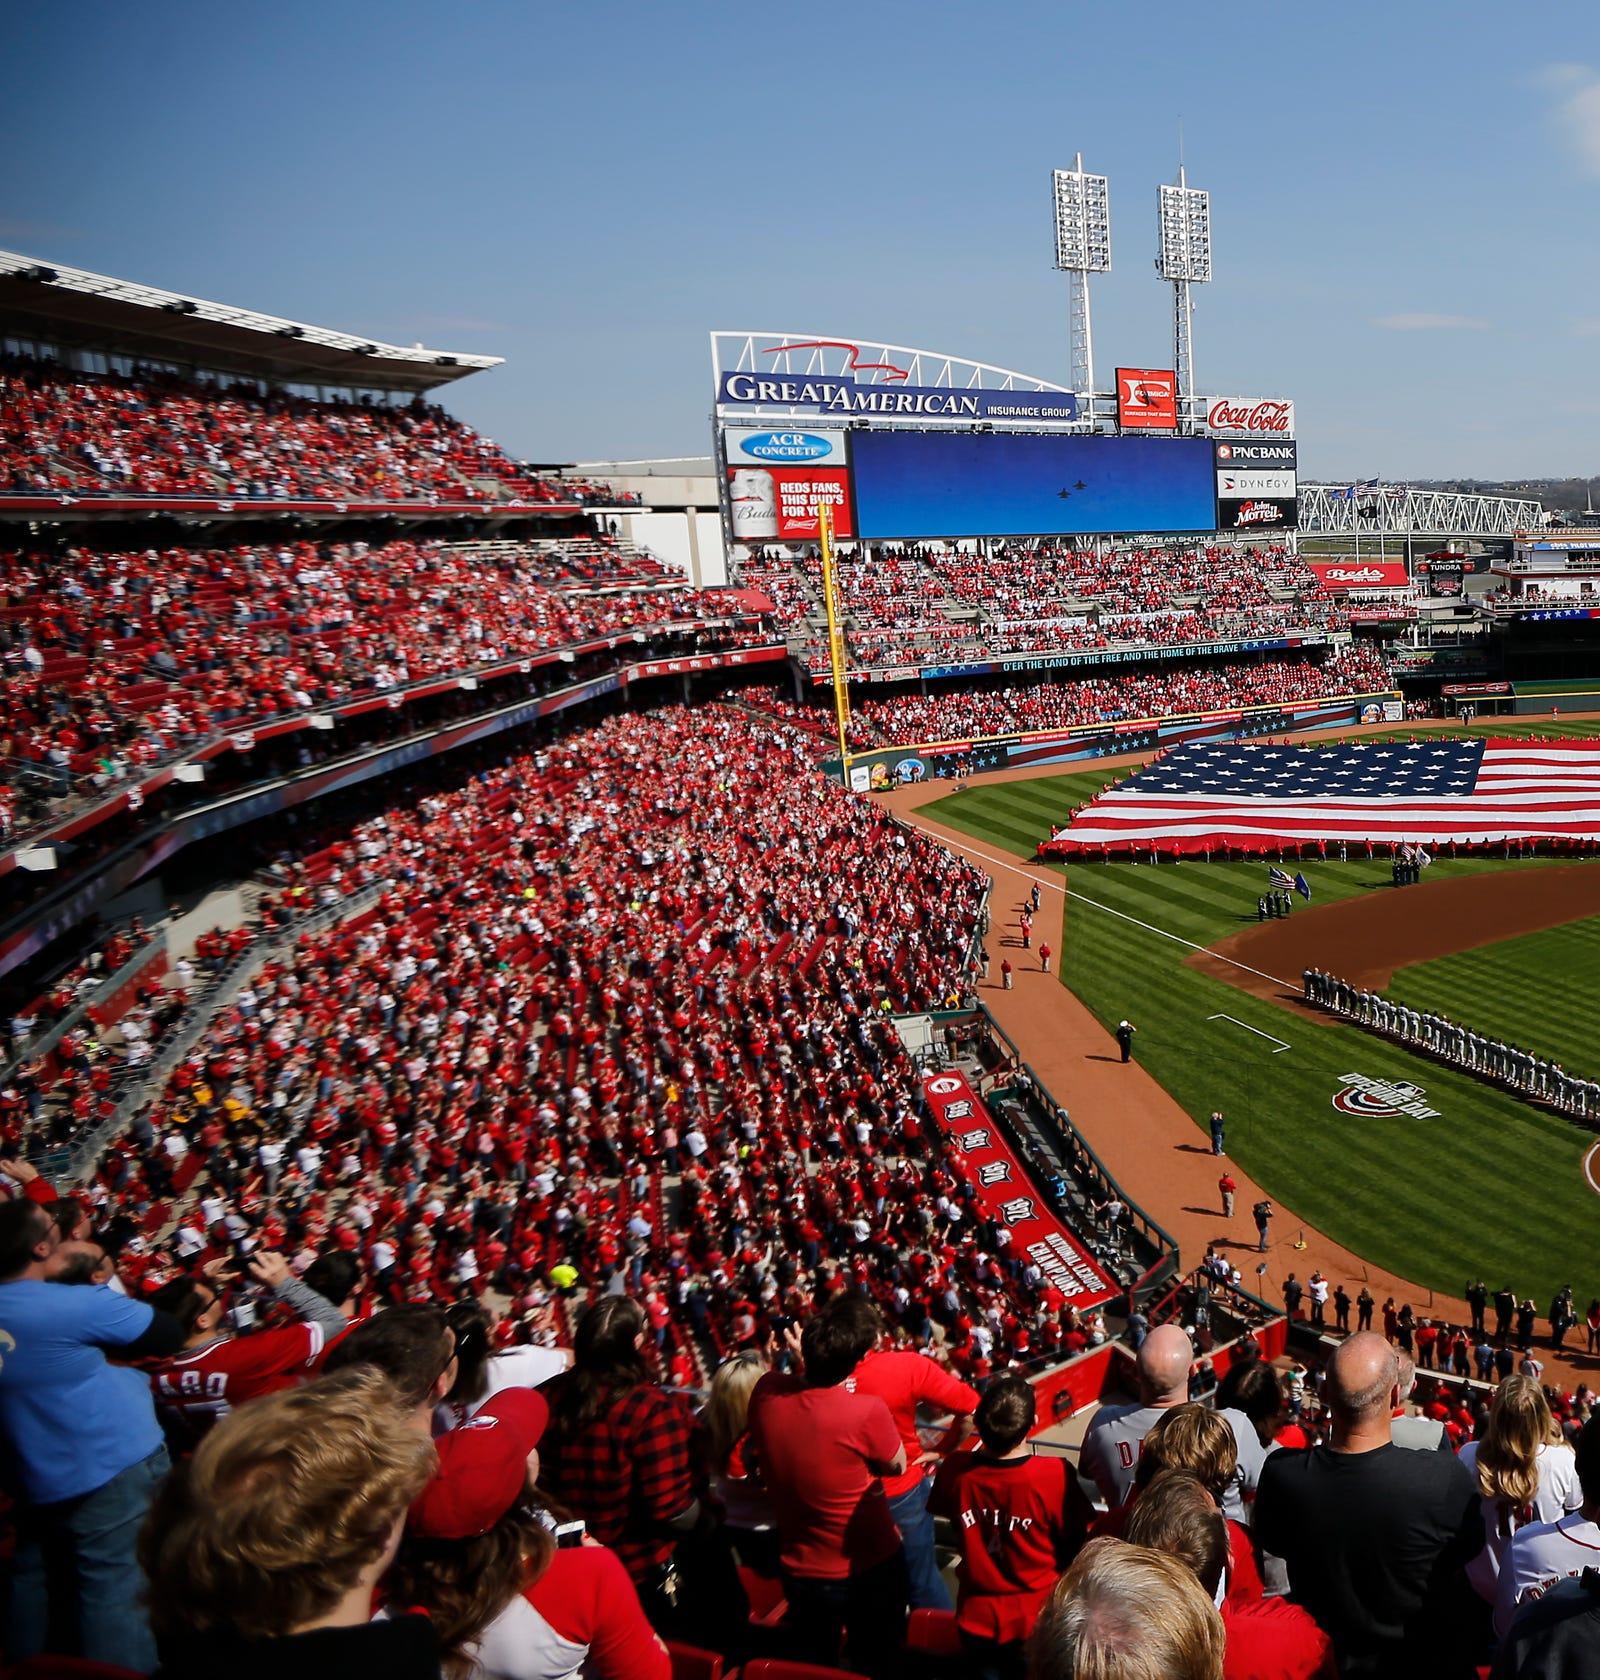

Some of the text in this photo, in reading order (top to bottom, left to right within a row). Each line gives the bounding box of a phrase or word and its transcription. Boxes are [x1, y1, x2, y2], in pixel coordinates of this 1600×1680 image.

[987, 405, 1071, 417] INSURANCE GROUP
[1208, 400, 1294, 431] Coca-Cola
[768, 433, 806, 445] ACR
[753, 446, 818, 456] CONCRETE
[780, 482, 844, 494] REDS FANS,
[1240, 479, 1289, 488] DYNEGY
[780, 494, 844, 505] THIS BUD'S
[782, 506, 805, 517] FOR
[1251, 501, 1270, 511] John
[1233, 505, 1283, 527] Morrell
[1124, 536, 1164, 545] ULTIMATE
[1178, 535, 1214, 544] SHUTTLE
[1325, 567, 1385, 582] Reds
[1003, 643, 1239, 671] O'ER THE LAND OF THE FREE AND THE HOME OF THE BRAVE
[1337, 1072, 1442, 1120] OPENING DAY
[1044, 1231, 1107, 1293] NATIONAL LEAGUE
[1026, 1241, 1085, 1297] CHAMPIONS
